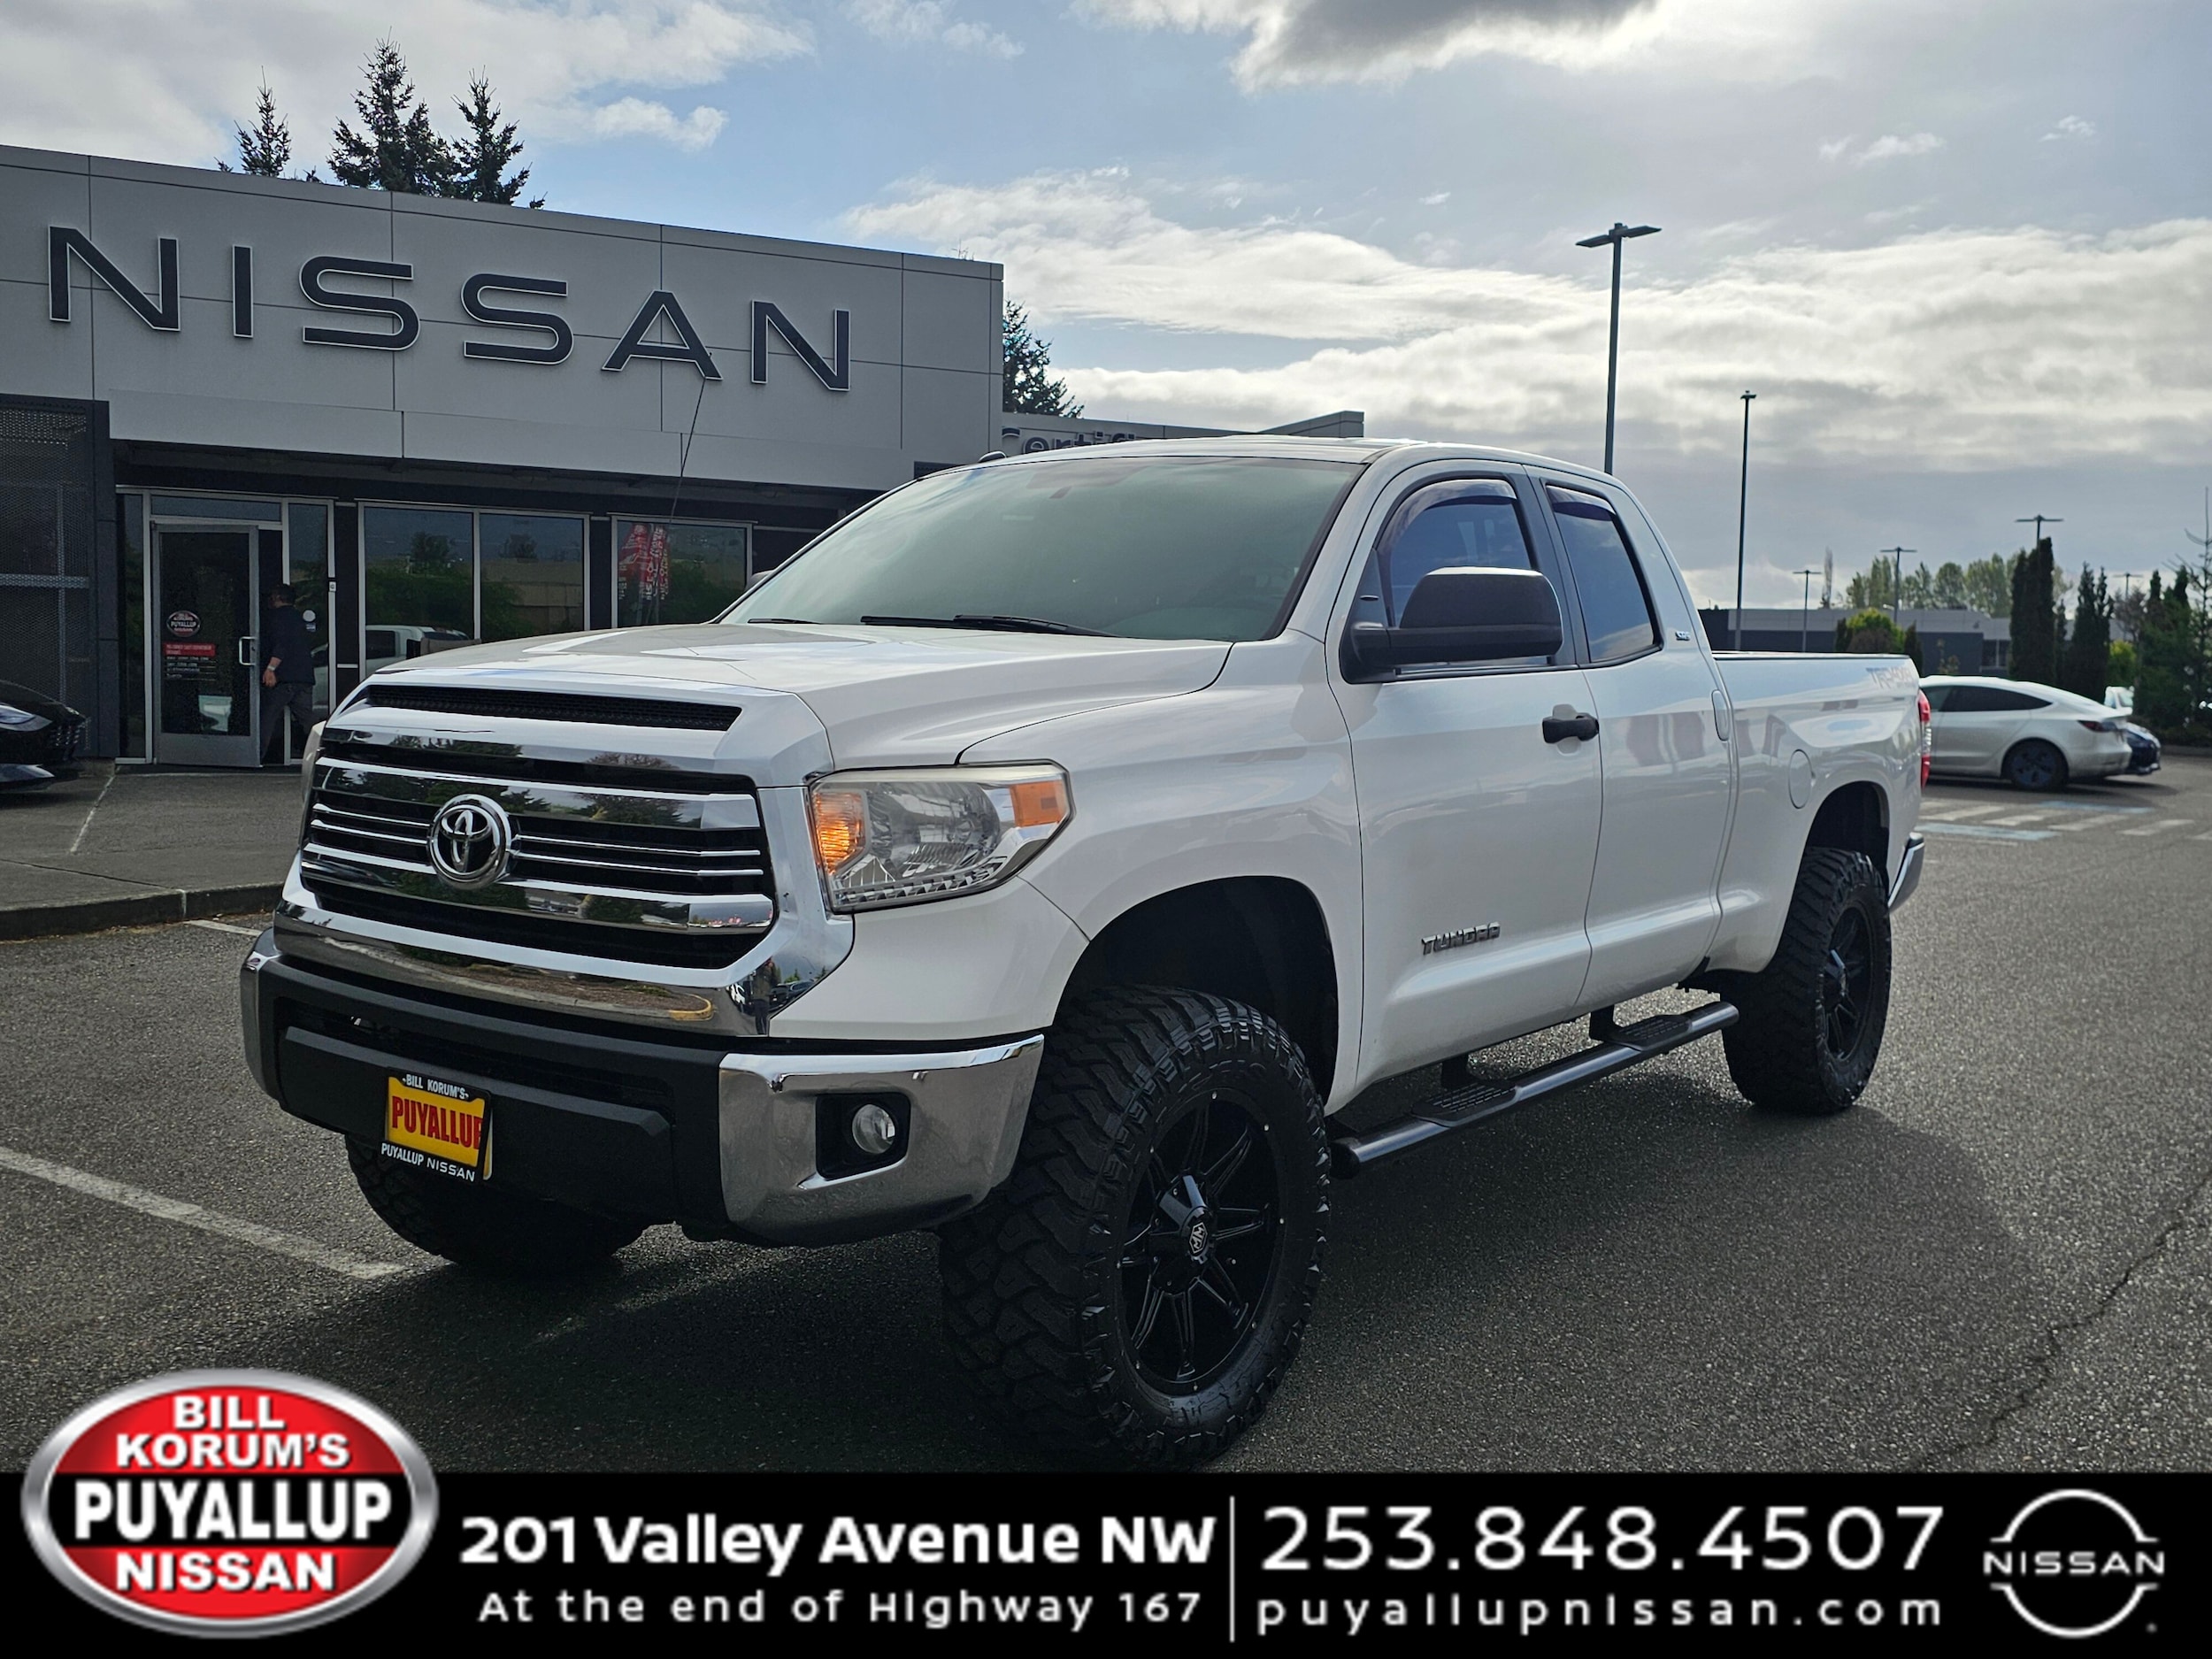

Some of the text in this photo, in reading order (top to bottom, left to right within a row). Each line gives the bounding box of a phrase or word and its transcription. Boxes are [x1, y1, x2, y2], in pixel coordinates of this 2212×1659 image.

[48, 226, 850, 391] NISSAN
[405, 1073, 465, 1100] BILL KORUM'S
[381, 1142, 475, 1183] PUYALLUP NISSAN
